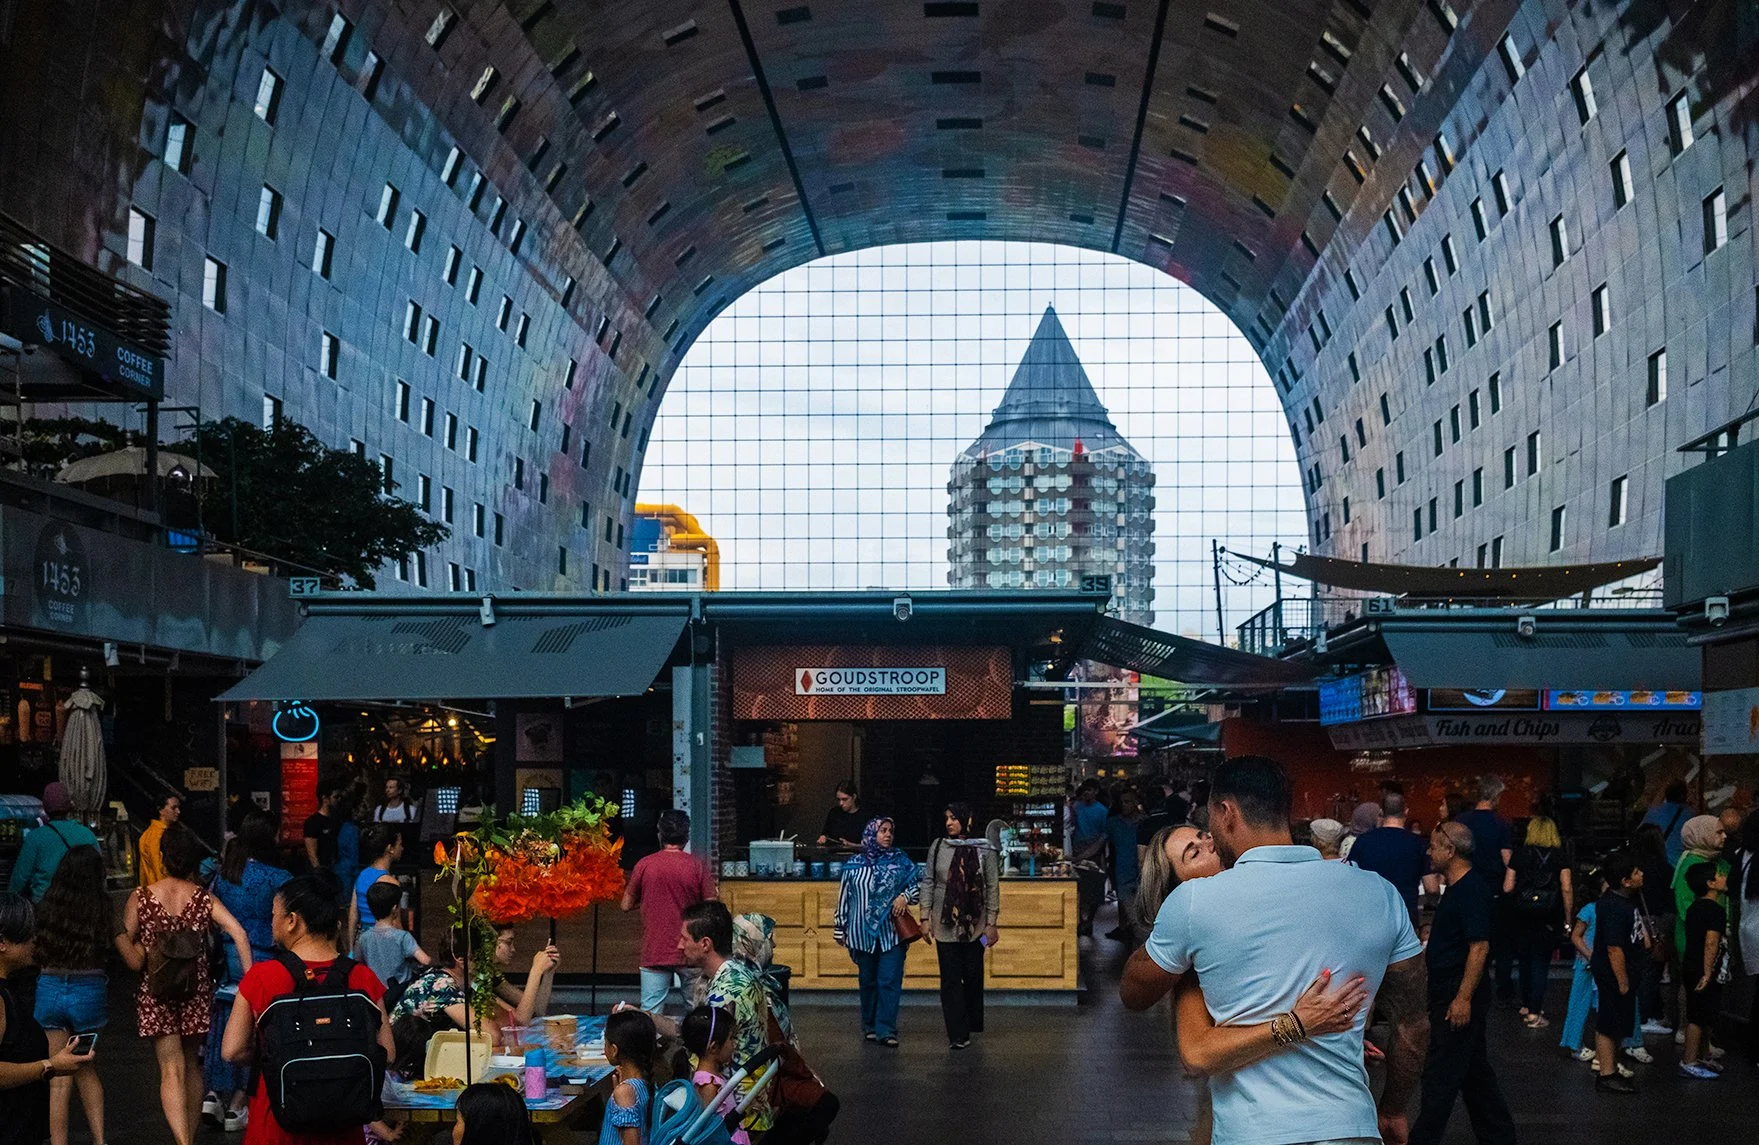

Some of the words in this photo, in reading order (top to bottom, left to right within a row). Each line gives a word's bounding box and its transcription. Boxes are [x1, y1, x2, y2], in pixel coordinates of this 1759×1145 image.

[61, 319, 96, 359] 1453
[117, 347, 153, 375] COFFEE
[119, 365, 152, 387] CORNER
[43, 560, 81, 597] 1453
[292, 579, 318, 594] 37
[1082, 576, 1108, 592] 39
[48, 599, 75, 615] COFFEE
[1368, 599, 1392, 612] 61
[815, 671, 940, 685] GOUDSTROOP
[1435, 718, 1471, 738] Fish
[1473, 719, 1511, 737] and
[1512, 717, 1561, 741] Chips
